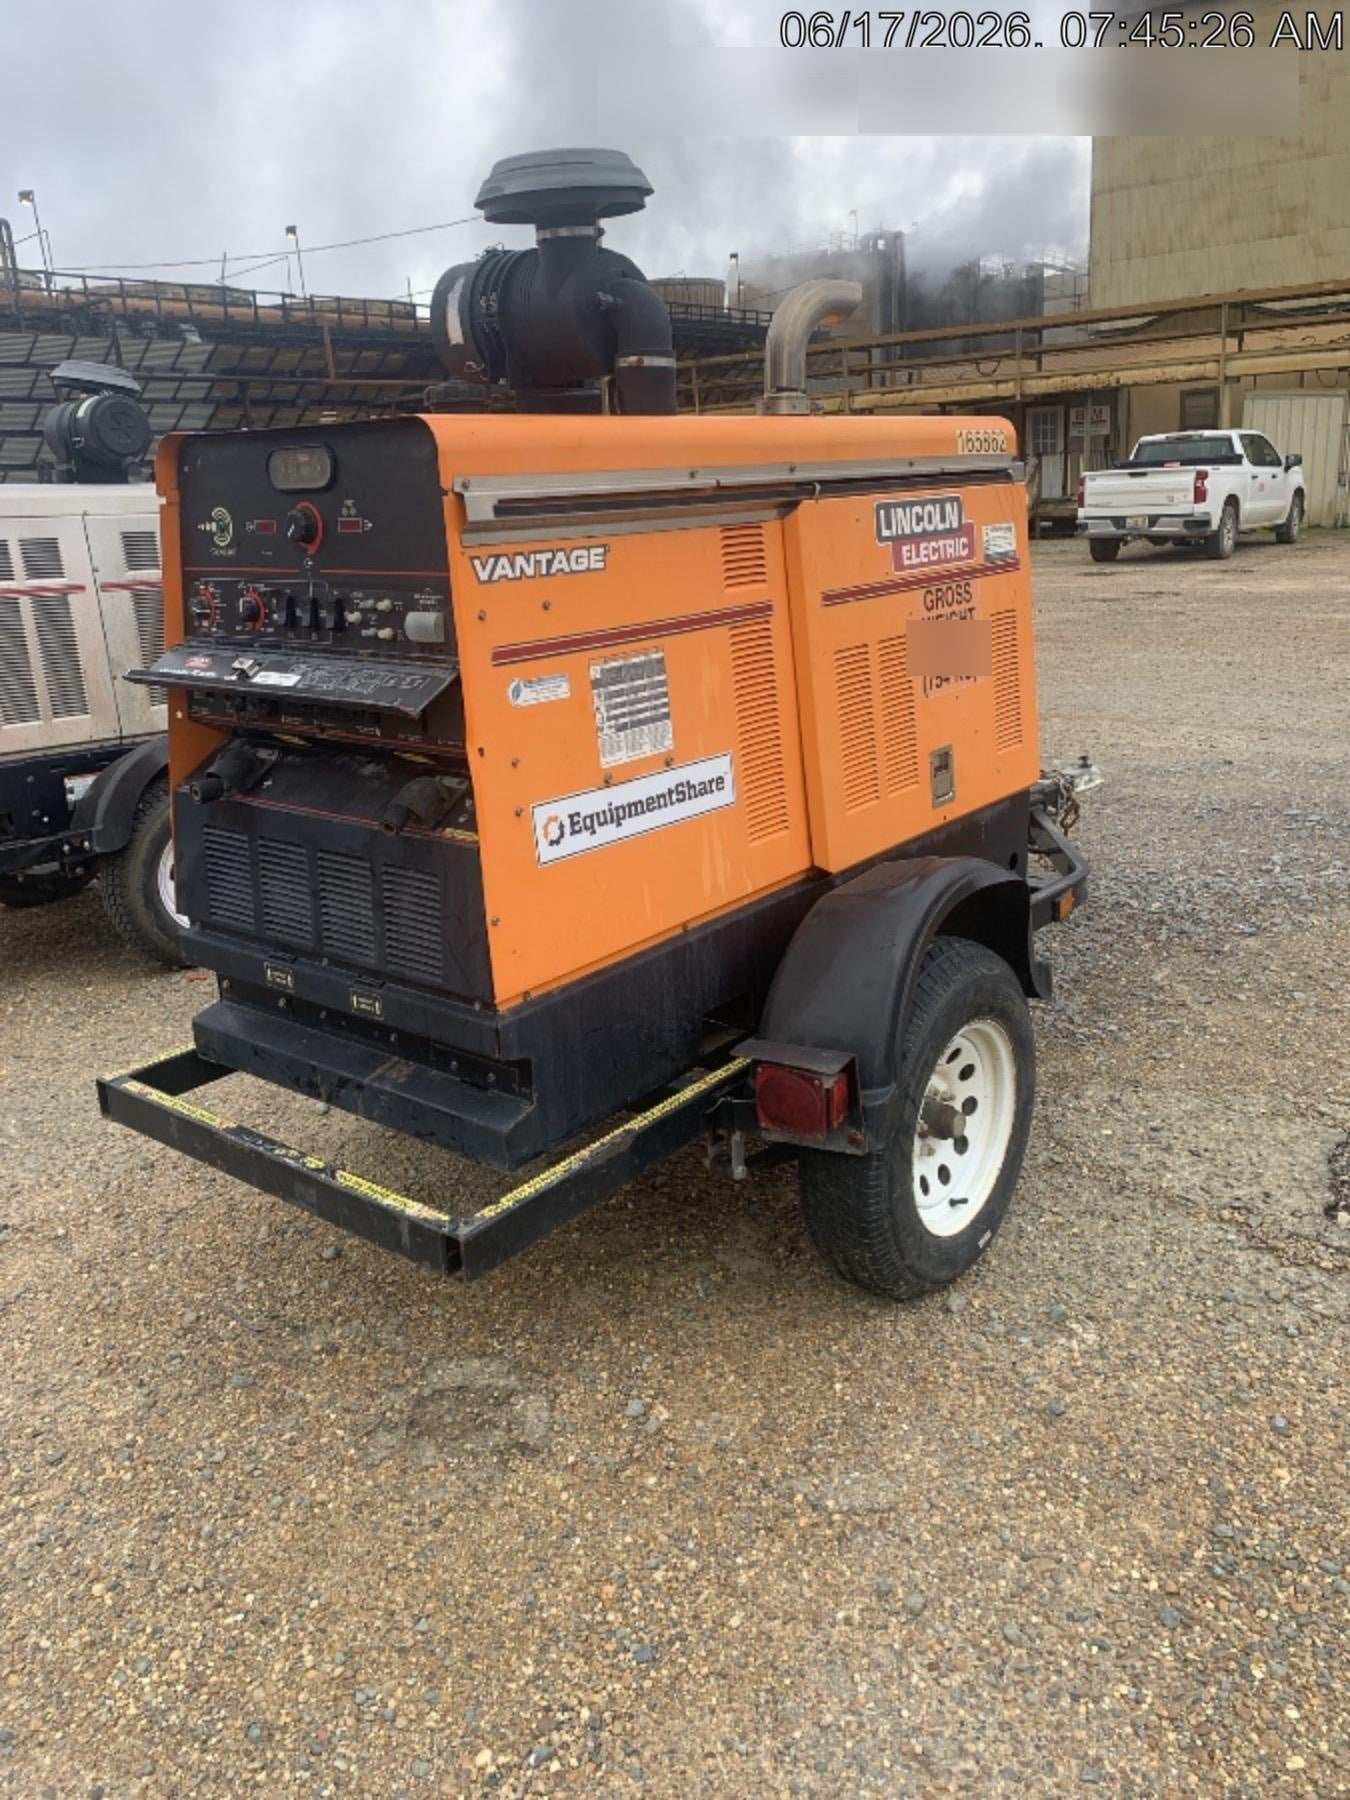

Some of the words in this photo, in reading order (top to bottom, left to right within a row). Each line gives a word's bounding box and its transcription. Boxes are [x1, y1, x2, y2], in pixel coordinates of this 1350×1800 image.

[879, 501, 959, 537] LINCOLN
[471, 545, 606, 582] VANTAGE
[902, 537, 969, 566] ELECTRIC
[923, 581, 973, 612] GROSS
[567, 775, 726, 837] EquipmentShare
